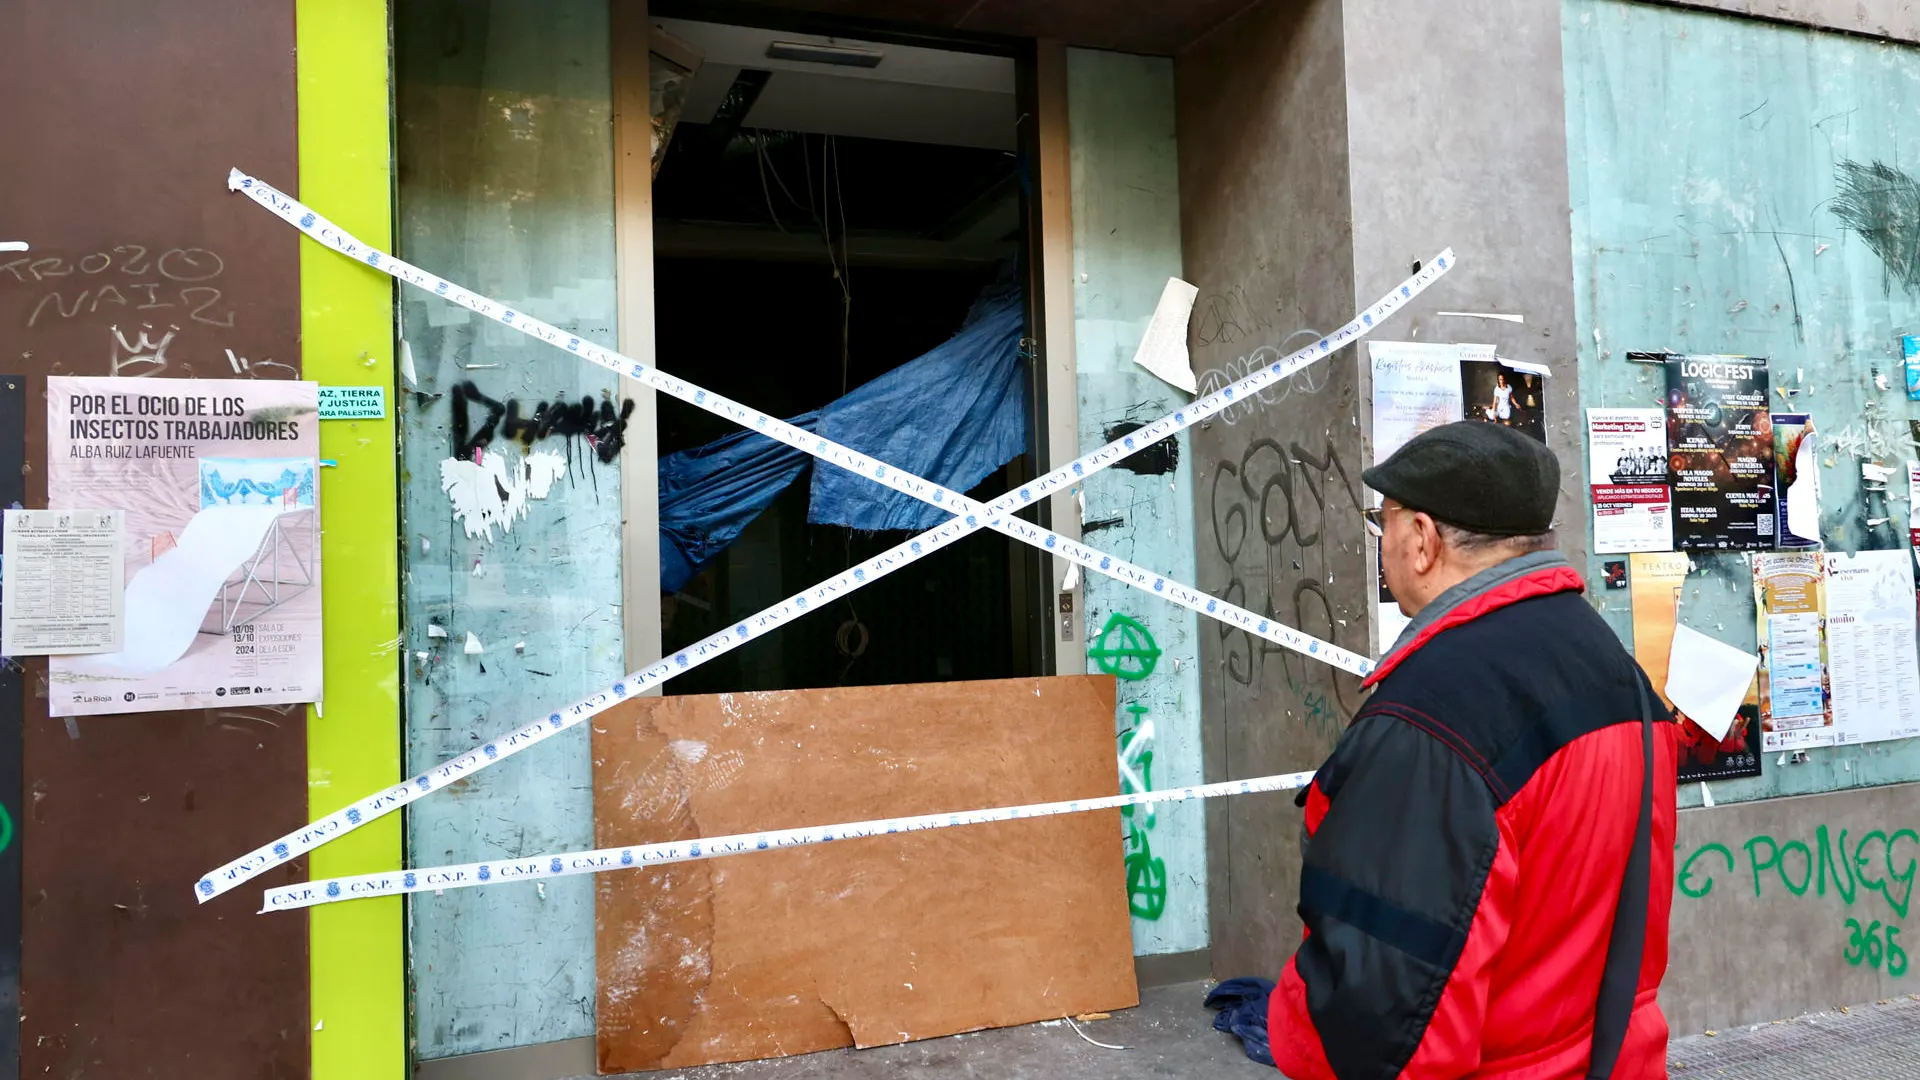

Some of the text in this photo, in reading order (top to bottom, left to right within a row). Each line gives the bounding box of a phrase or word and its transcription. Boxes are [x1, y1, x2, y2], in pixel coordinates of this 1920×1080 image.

[1681, 362, 1754, 380] LOGIC FEST
[318, 390, 381, 398] AZ, TIERRA
[70, 395, 244, 417] POR EL OCIO DE LOS
[70, 419, 299, 441] INSECTOS TRABAJADORES
[255, 187, 291, 215] C.N.P.
[321, 228, 357, 255] C.N.P.
[388, 264, 424, 285] C.N.P.
[1007, 521, 1037, 540] C.N.P.
[1062, 544, 1093, 563] C.N.P.
[1116, 565, 1146, 584] C.N.P.
[1170, 587, 1199, 605] C.N.P.
[1222, 608, 1252, 627] C.N.P.
[1274, 629, 1301, 647] C.N.P.
[1324, 649, 1351, 666] C.N.P.
[1592, 422, 1645, 432] Marketing Digital
[70, 445, 196, 459] ALBA RUIZ LAFUENTE
[1642, 562, 1682, 571] TEATRO
[1830, 613, 1855, 624] otoño
[232, 624, 254, 634] 10/09
[259, 623, 285, 632] SALA DE
[233, 633, 255, 643] 13/10
[259, 633, 302, 642] EXPOSICIONES
[235, 645, 255, 655] 2024
[259, 645, 266, 654] DE
[267, 645, 277, 653] LA
[93, 695, 112, 703] Rioja
[272, 889, 315, 905] C.N.P.
[350, 879, 392, 893] C.N.P.
[427, 871, 467, 884] C.N.P.
[500, 864, 540, 877] C.N.P.
[572, 856, 610, 869] C.N.P.
[642, 849, 680, 861] C.N.P.
[710, 842, 746, 853] C.N.P.
[1844, 918, 1908, 978] 365
